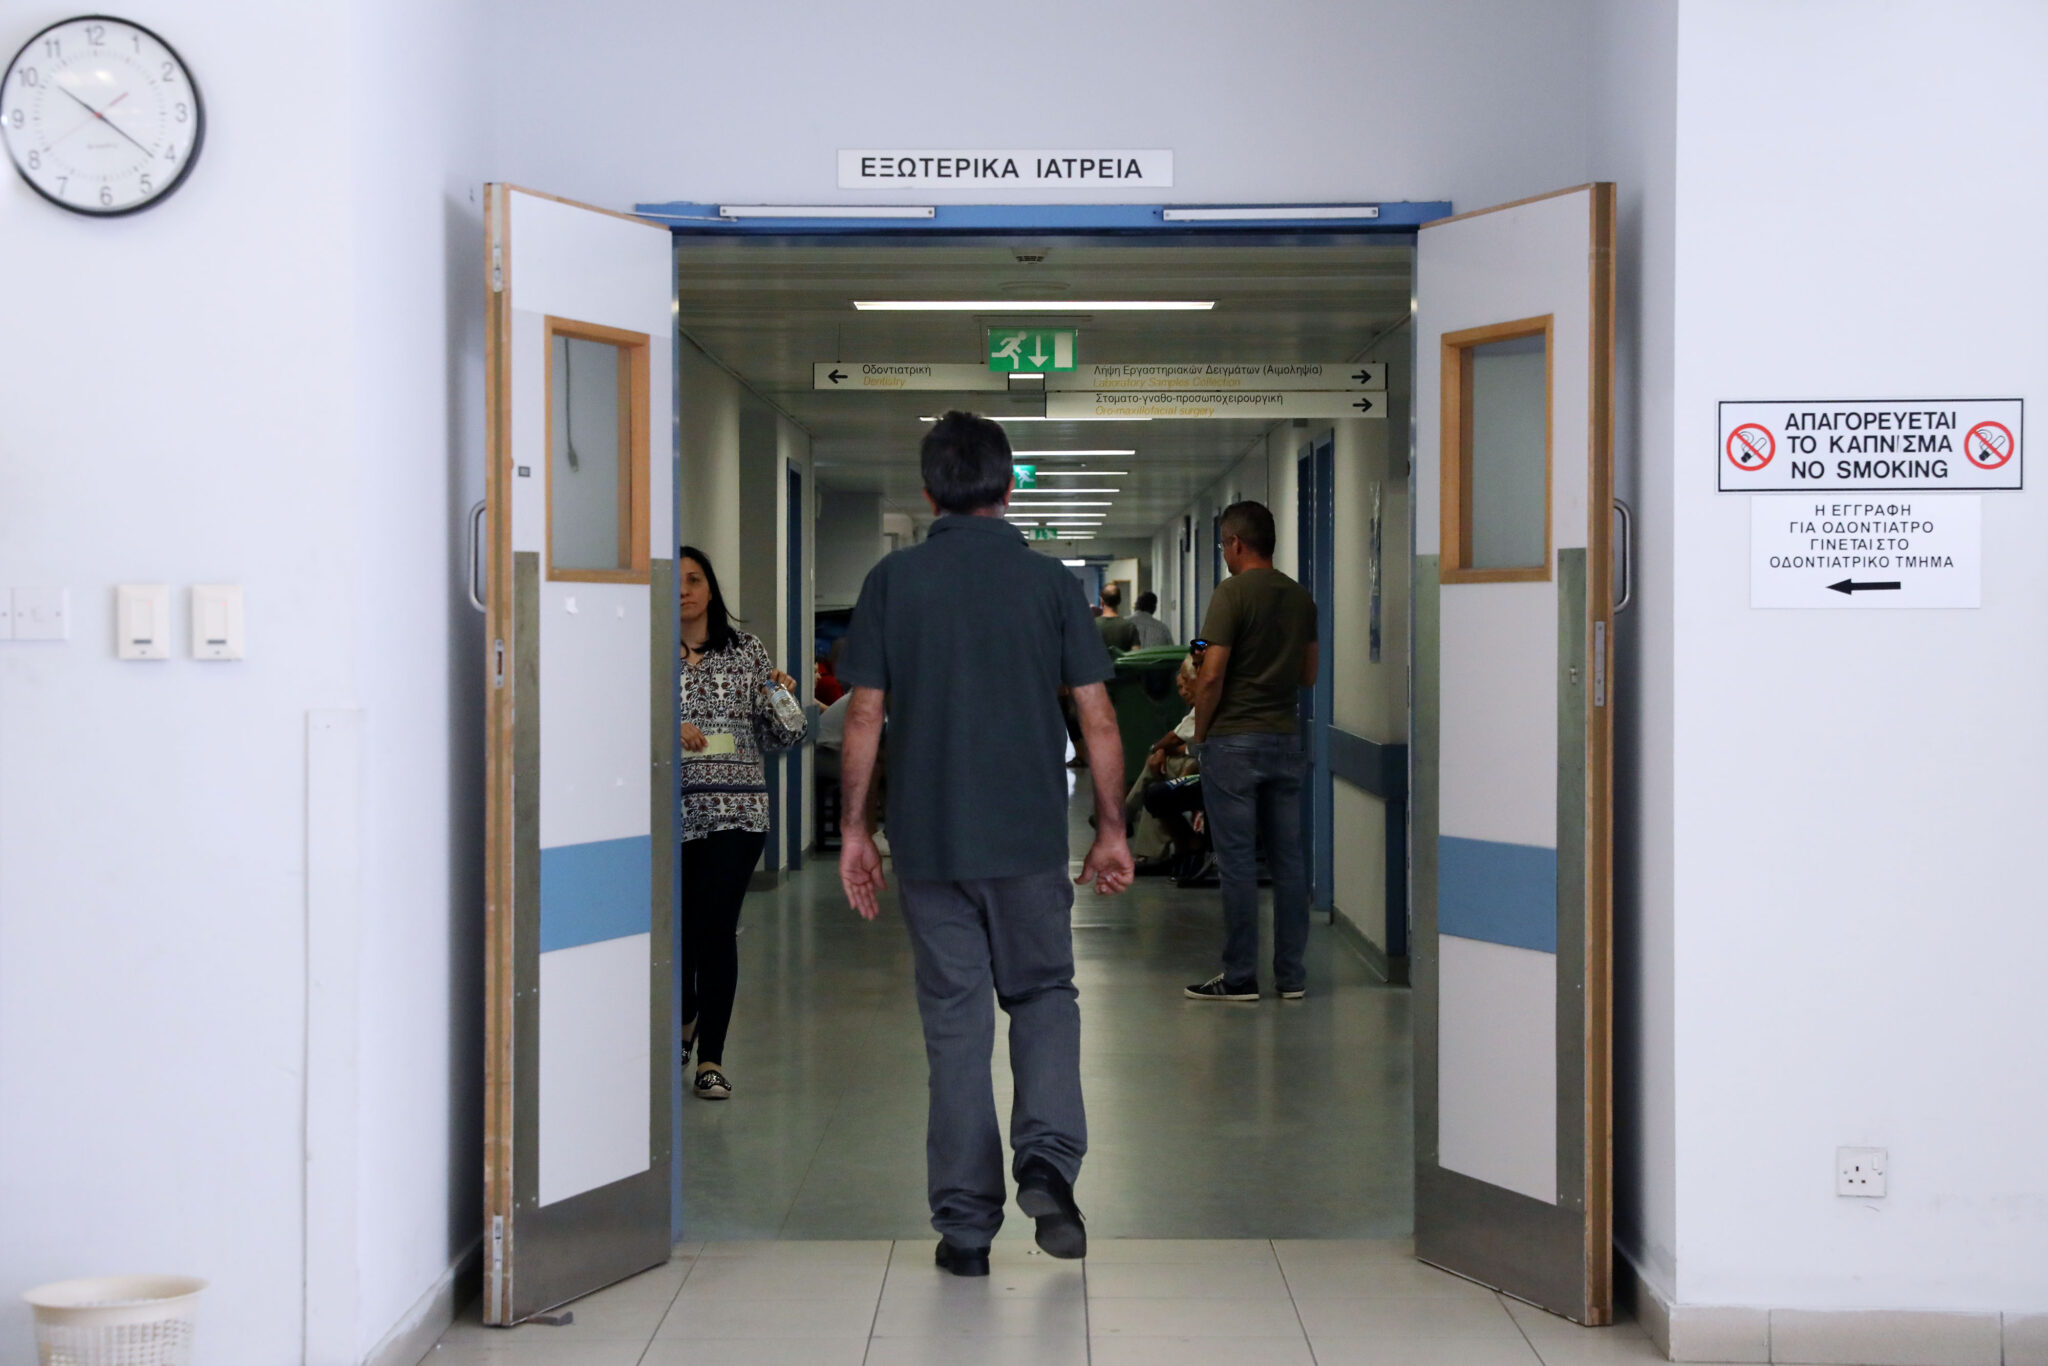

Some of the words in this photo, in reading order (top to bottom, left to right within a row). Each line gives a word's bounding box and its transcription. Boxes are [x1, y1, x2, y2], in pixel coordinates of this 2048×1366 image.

[85, 25, 105, 46] 12
[132, 35, 140, 54] 1
[44, 39, 61, 58] 11
[18, 66, 38, 87] 10
[162, 61, 174, 82] 2
[12, 108, 24, 129] 9
[175, 102, 187, 123] 3
[28, 150, 41, 170] 8
[164, 144, 176, 163] 4
[861, 158, 1019, 178] ΕΞΩΤΕΡΙΚΑ
[1036, 158, 1143, 179] ΙΑΤΡΕΙΑ
[56, 176, 68, 197] 7
[140, 173, 152, 194] 5
[100, 186, 113, 206] 6
[862, 364, 931, 376] Οδοντιατρική
[1123, 365, 1202, 377] Εργαστηριακών
[1206, 364, 1260, 376] Δειγμάτων
[863, 376, 906, 387] Dentistry
[1093, 378, 1145, 388] Laboratory
[1148, 378, 1189, 388] Samples
[1192, 377, 1241, 387] Collection
[1095, 405, 1177, 416] Oro-maxillofacial
[1179, 407, 1215, 417] surgery
[1784, 411, 1957, 431] ΑΠΑΓΟΡΕΥΕΤΑΙ
[1786, 435, 1817, 454] ΤΟ
[1791, 460, 1825, 479] NO
[1836, 459, 1948, 479] SMOKING
[1815, 504, 1825, 517] Η
[1832, 504, 1911, 517] ΕΓΓΡΑΦΗ
[1789, 521, 1816, 534] ΓΙΑ
[1822, 521, 1934, 534] ΟΔΟΝΤΙΑΤΡΟ
[1810, 538, 1873, 551] ΓΙΝΕΤΑΙ
[1876, 538, 1909, 551] ΣΤΟ
[1769, 556, 1890, 569] ΟΔΟΝΤΙΑΤΡΙΚΟ
[1895, 556, 1954, 568] ΤΜΗΜΑ
